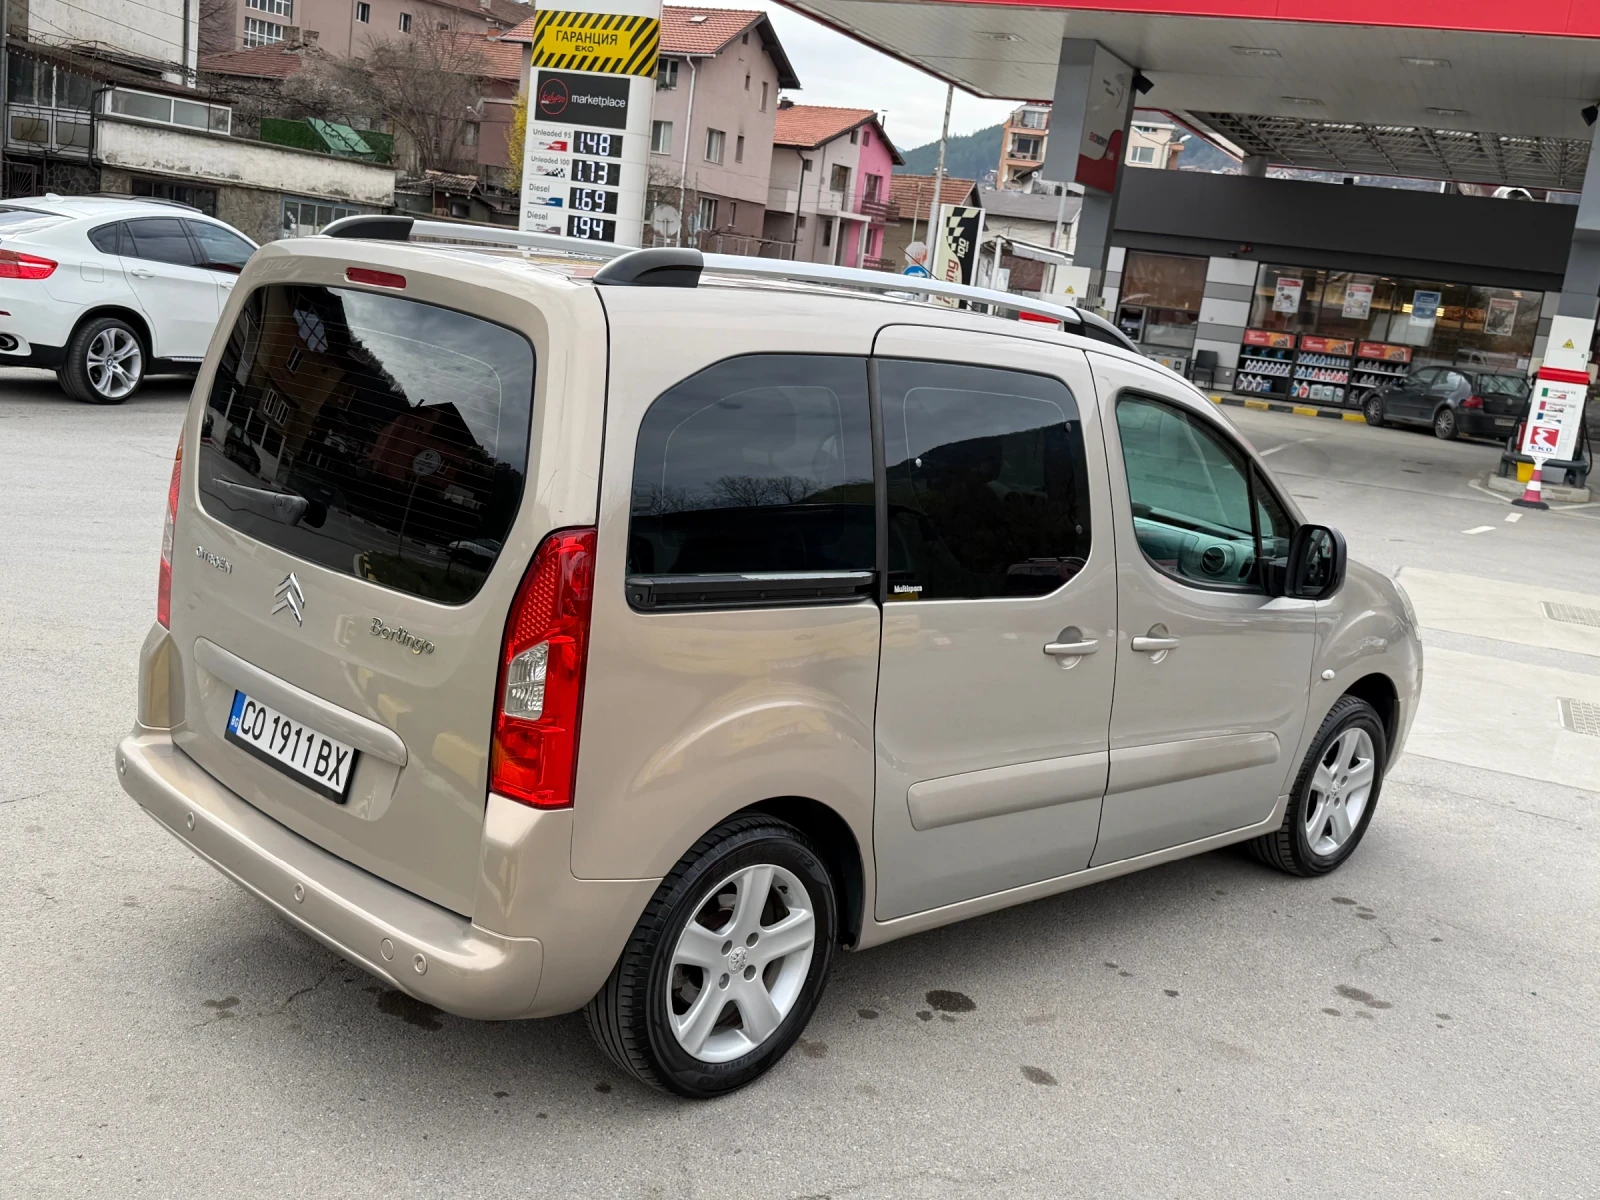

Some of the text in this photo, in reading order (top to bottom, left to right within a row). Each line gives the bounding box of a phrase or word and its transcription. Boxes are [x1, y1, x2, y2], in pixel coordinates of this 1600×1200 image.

[556, 30, 618, 46] ГАРАНЦИЯ
[575, 45, 594, 53] EKO
[571, 93, 626, 108] marketplace
[533, 128, 611, 156] Unleaded 95 1.48
[531, 155, 609, 185] Unleaded 100 1.73
[529, 183, 550, 193] Diesel
[575, 188, 606, 212] 1.69
[527, 211, 548, 220] Diesel
[573, 216, 604, 239] 1.94
[957, 237, 967, 258] 100
[1531, 445, 1552, 453] EKO
[369, 616, 436, 656] Berlingo
[230, 715, 239, 728] BG
[241, 700, 349, 787] CO 1911 BX
